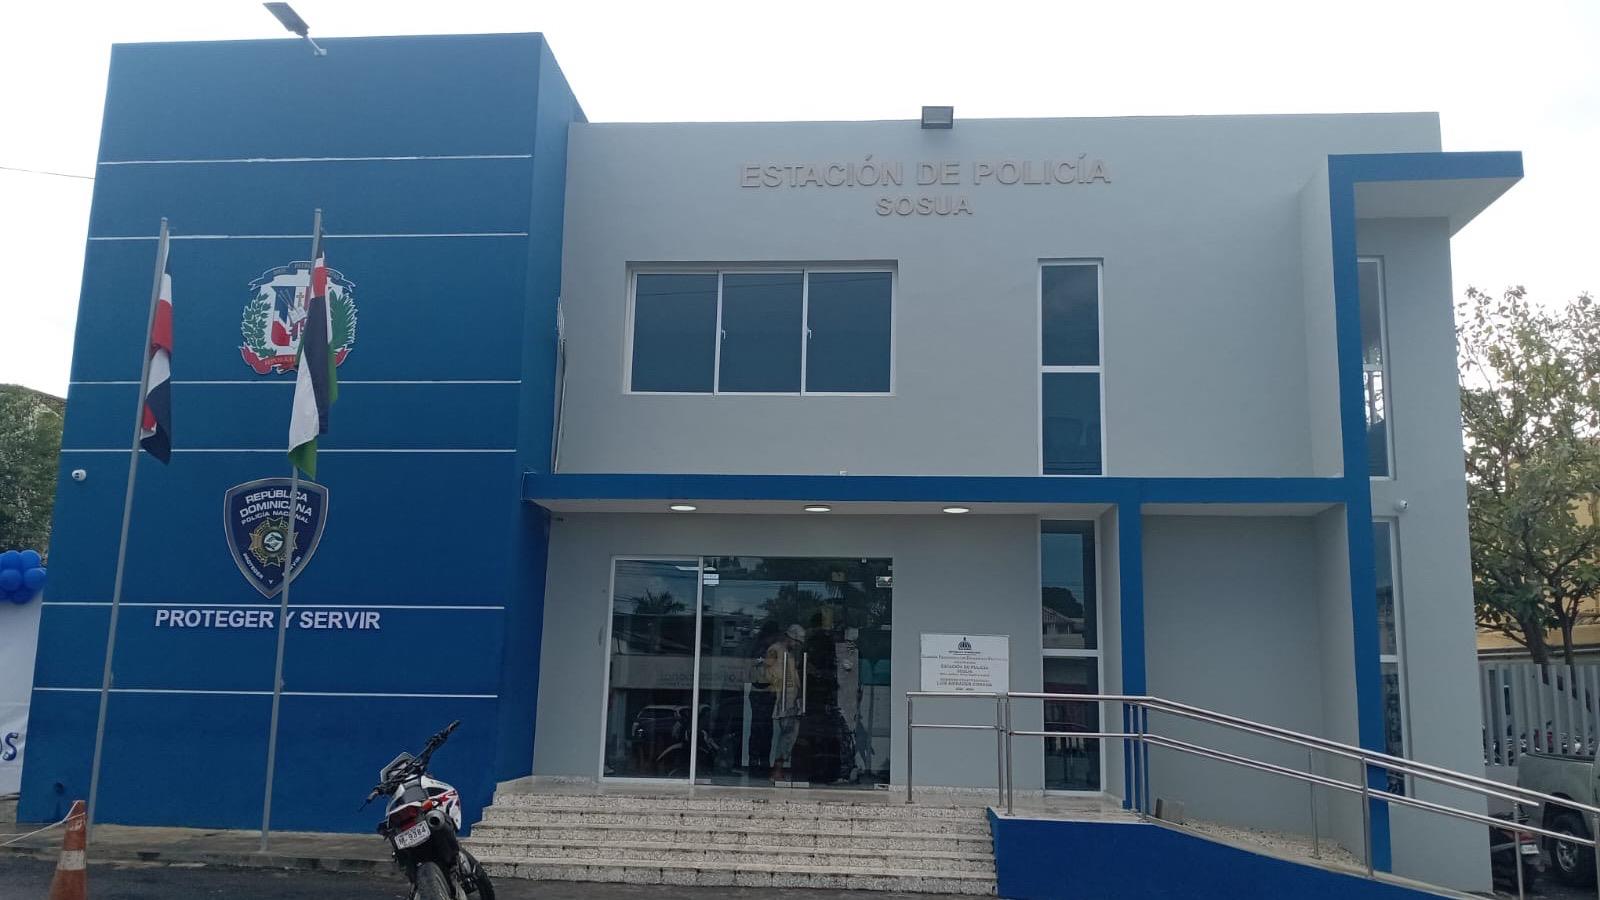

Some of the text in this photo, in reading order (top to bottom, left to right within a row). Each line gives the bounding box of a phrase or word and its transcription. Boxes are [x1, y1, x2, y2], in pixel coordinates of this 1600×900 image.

[740, 153, 1112, 188] ESTACIÓN DE POLICÍA
[875, 195, 974, 217] SOSUA
[240, 500, 312, 518] DOMINICNA
[272, 510, 309, 524] NACNAL
[155, 609, 381, 629] PROTEGER Y SERVIR
[0, 732, 19, 761] S
